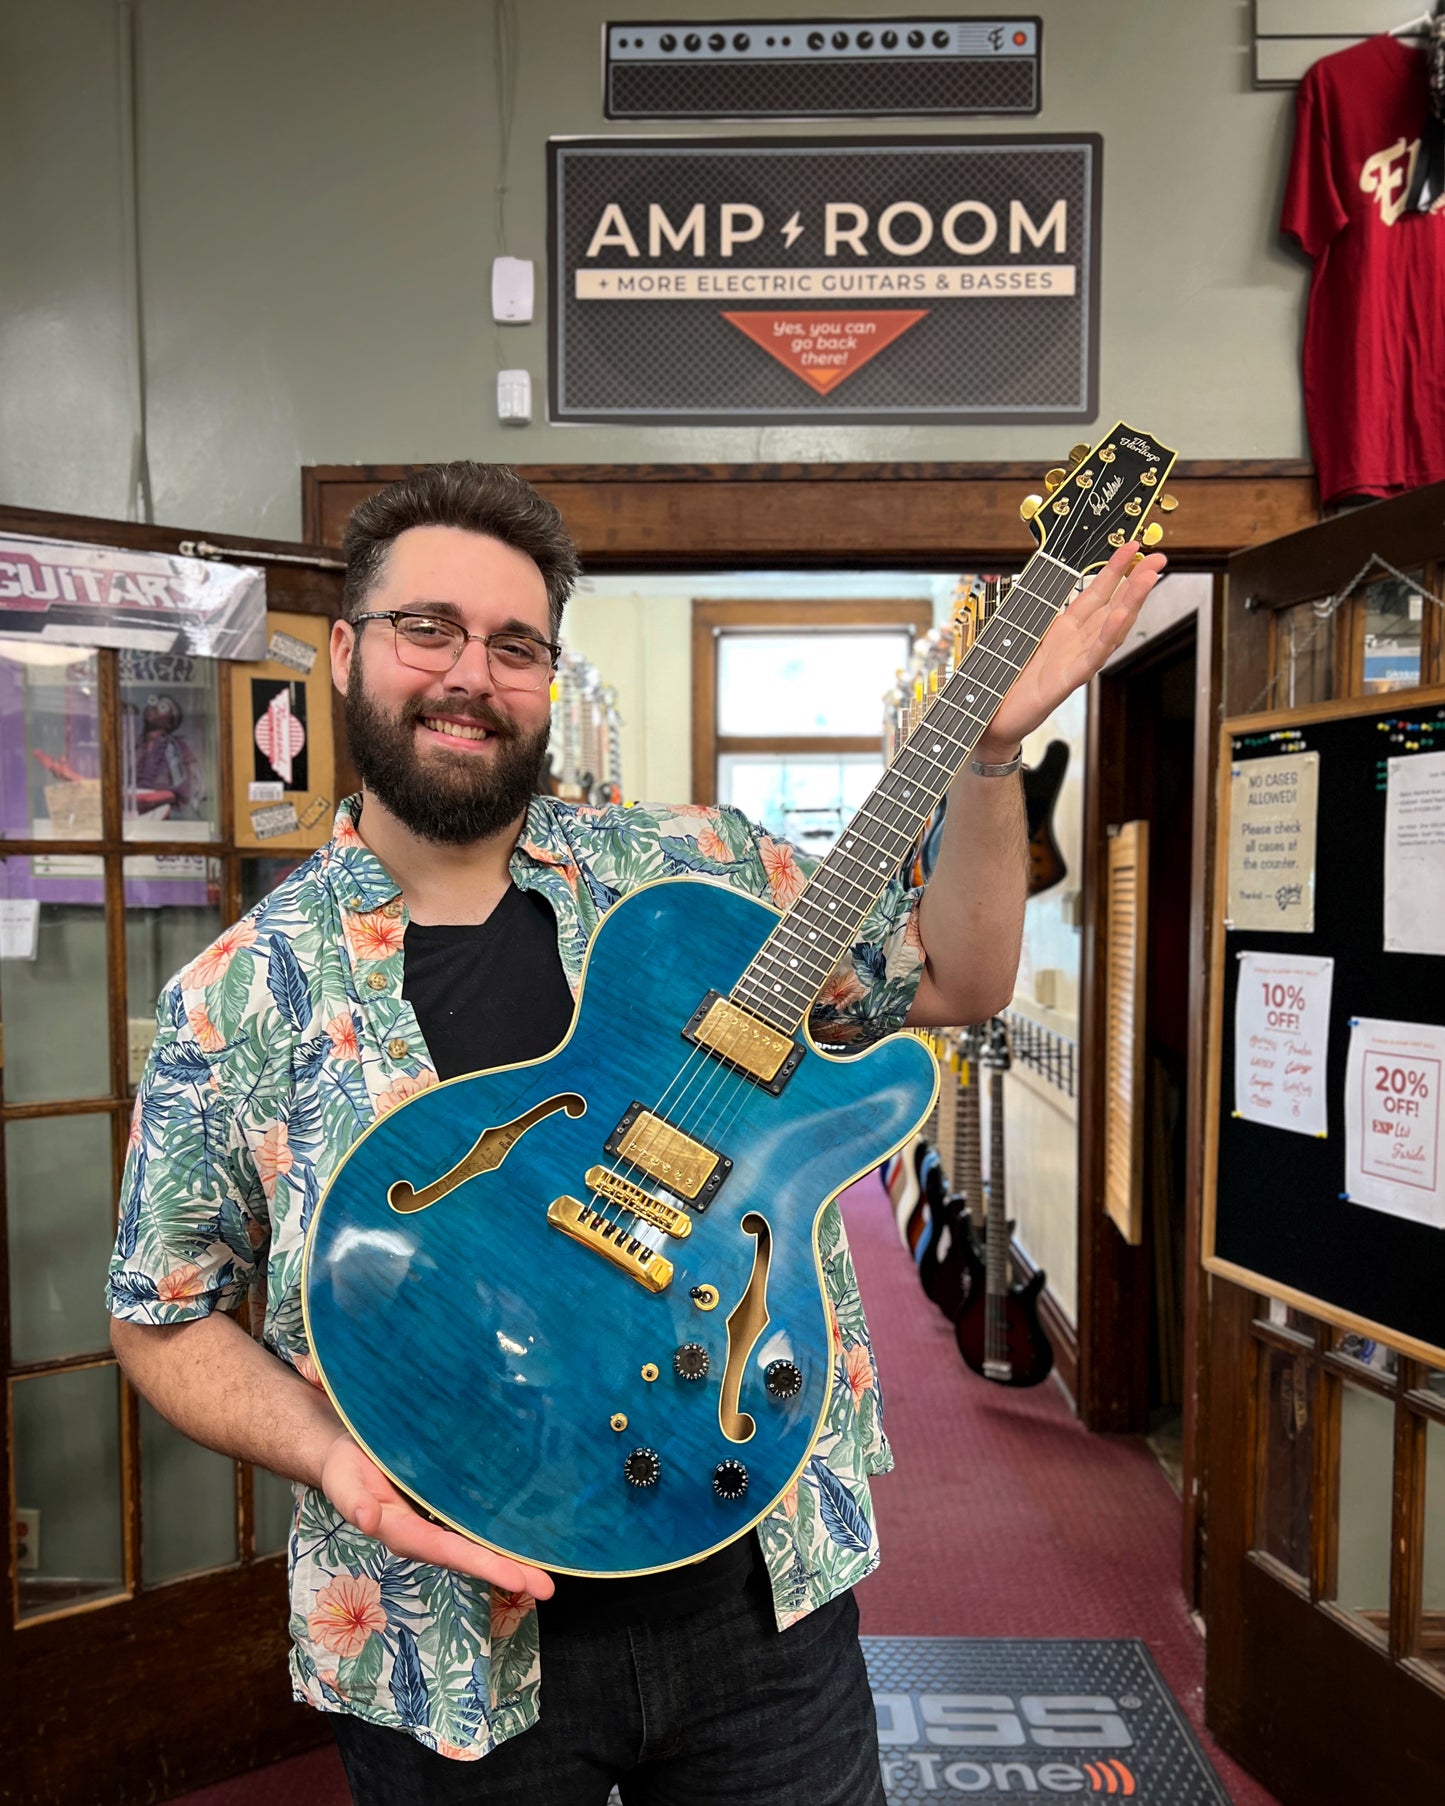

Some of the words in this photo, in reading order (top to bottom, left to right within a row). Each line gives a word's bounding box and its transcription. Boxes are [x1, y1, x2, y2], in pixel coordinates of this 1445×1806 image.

[586, 203, 765, 257] AMP
[825, 199, 1067, 256] ROOM
[617, 276, 687, 292] MORE
[697, 275, 812, 292] ELECTRIC
[821, 274, 926, 292] GUITARS
[935, 274, 950, 290] &
[960, 272, 1054, 290] BASSES
[773, 321, 806, 336] Yes,
[809, 322, 842, 337] you
[845, 322, 876, 335] can
[791, 337, 813, 353] go
[817, 337, 857, 350] back
[801, 352, 848, 366] there!
[1133, 437, 1151, 451] The
[1249, 775, 1263, 788] NO
[1265, 772, 1298, 787] CASES
[1248, 790, 1297, 805] ALLOWED!
[1242, 823, 1271, 836] Please
[1274, 820, 1302, 834] check
[1245, 840, 1256, 853] all
[1258, 842, 1285, 853] cases
[1288, 840, 1298, 851] at
[1243, 858, 1258, 870] the
[1260, 857, 1300, 870] counter.
[1262, 982, 1306, 1011] 10%
[1267, 1011, 1300, 1030] OFF!
[1375, 1065, 1429, 1099] 20%
[1384, 1097, 1420, 1118] OFF!
[881, 1753, 1086, 1792] rTone
